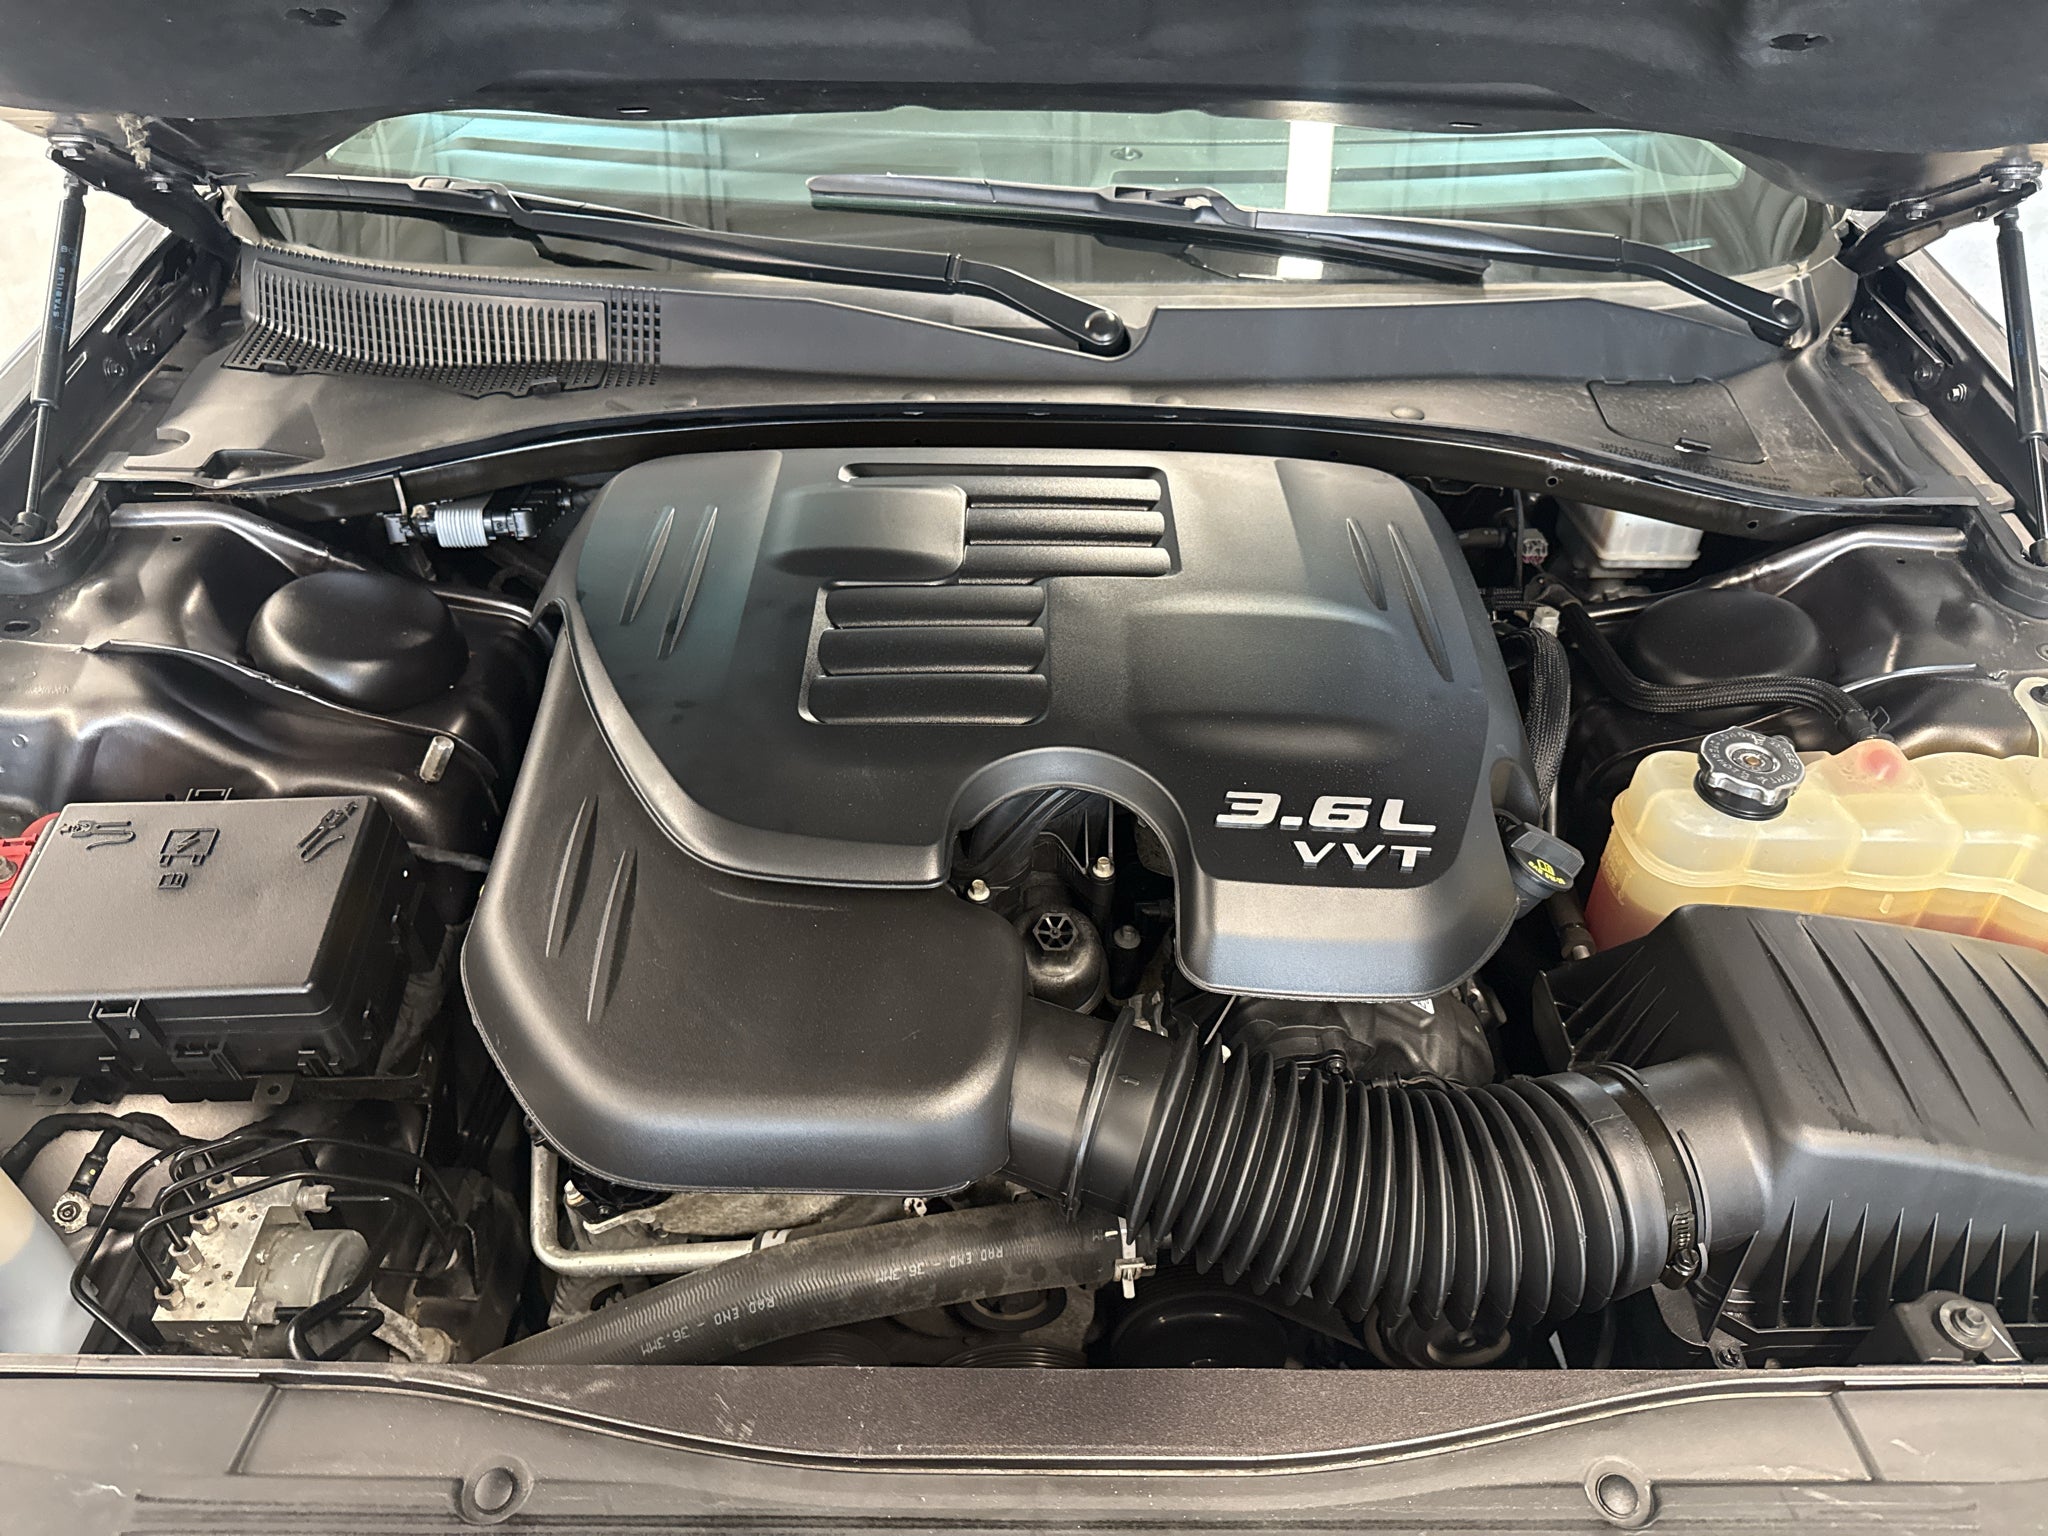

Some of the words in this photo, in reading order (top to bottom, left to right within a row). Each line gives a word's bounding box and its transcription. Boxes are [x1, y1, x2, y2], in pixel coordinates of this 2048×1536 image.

[53, 266, 66, 318] STABILUS
[1214, 790, 1437, 835] 3.6L
[1294, 840, 1432, 872] VVT
[949, 1252, 973, 1269] END
[980, 1245, 1004, 1261] RAD
[874, 1261, 926, 1284] 36.3MM
[713, 1306, 740, 1326] END
[747, 1294, 776, 1315] RAD
[639, 1324, 690, 1357] 36.3MM
